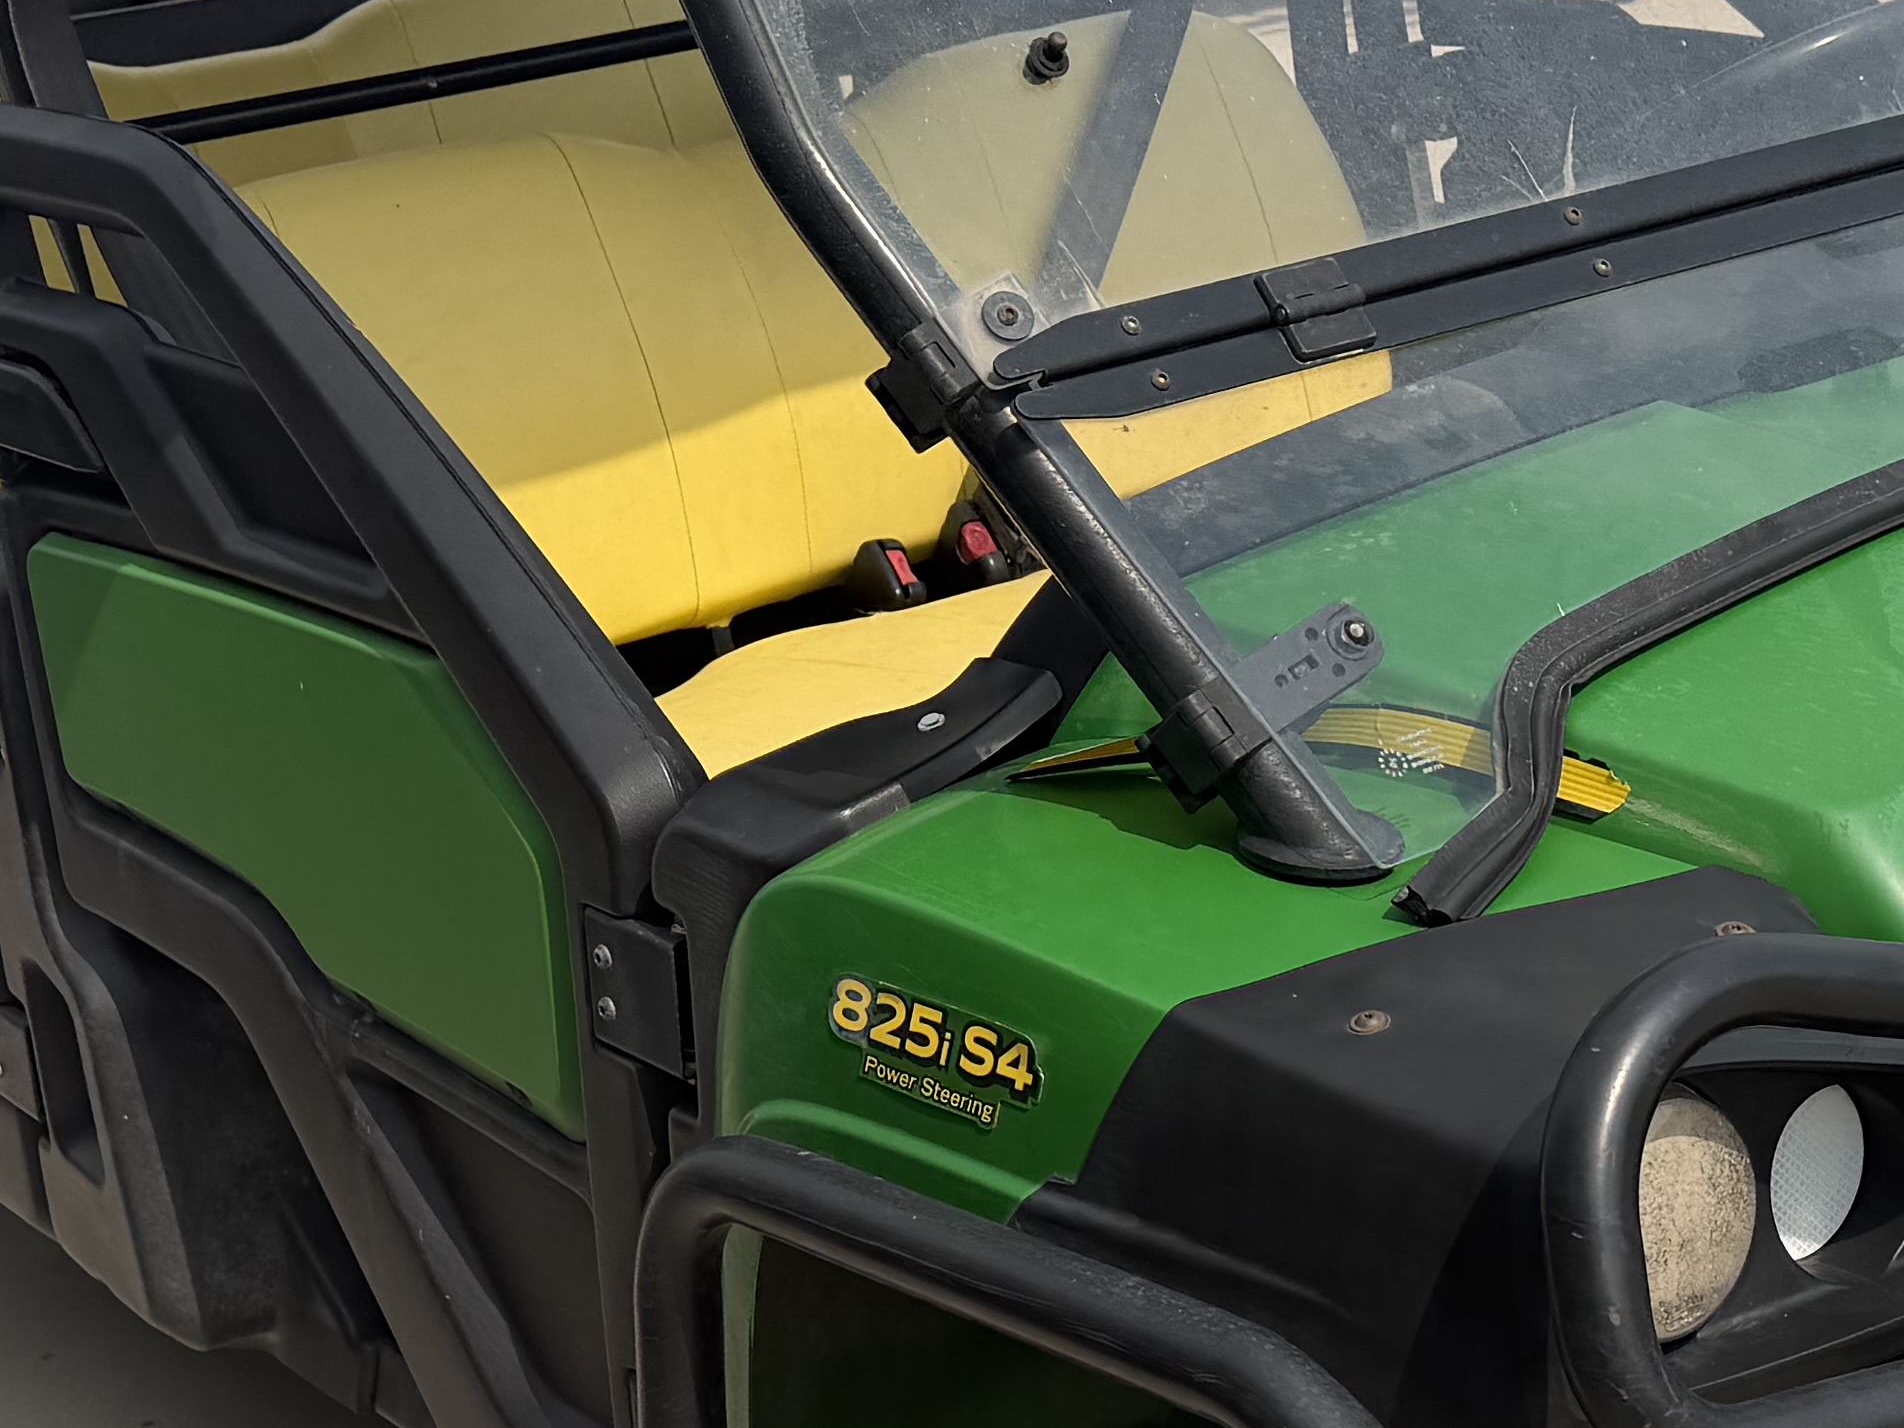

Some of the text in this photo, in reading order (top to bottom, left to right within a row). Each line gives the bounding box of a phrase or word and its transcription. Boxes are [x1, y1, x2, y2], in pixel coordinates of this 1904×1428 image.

[832, 979, 1034, 1091] 825i S4
[865, 1056, 995, 1123] Power Steering
